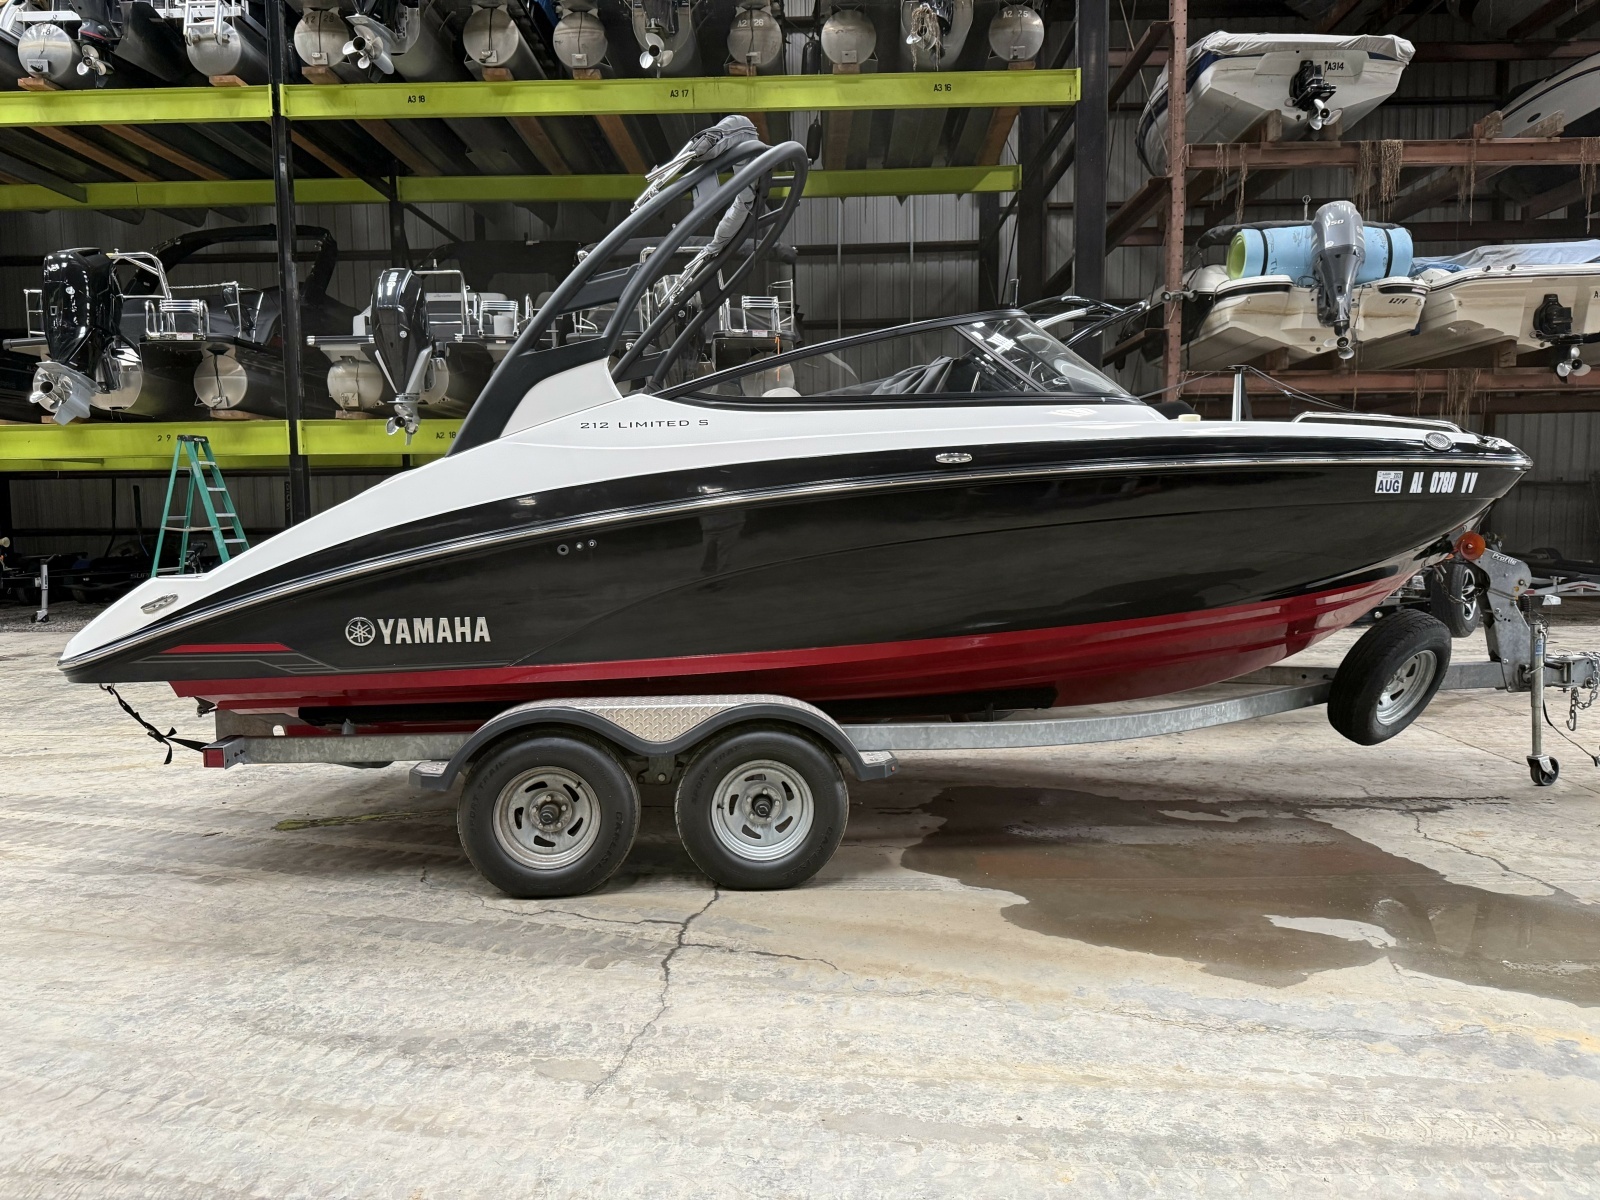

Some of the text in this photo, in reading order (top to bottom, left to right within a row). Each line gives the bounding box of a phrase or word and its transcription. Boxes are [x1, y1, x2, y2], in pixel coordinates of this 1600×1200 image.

[1326, 61, 1345, 71] A314
[933, 83, 952, 92] A3 16
[670, 89, 689, 98] A3 17
[407, 94, 426, 104] A3 18
[618, 420, 690, 429] LIMITED
[435, 432, 445, 440] A2
[1377, 479, 1400, 493] AUG
[1409, 471, 1424, 494] AL
[1429, 471, 1458, 494] 0780
[1491, 552, 1518, 566] Profile
[377, 616, 492, 645] YAMAHA
